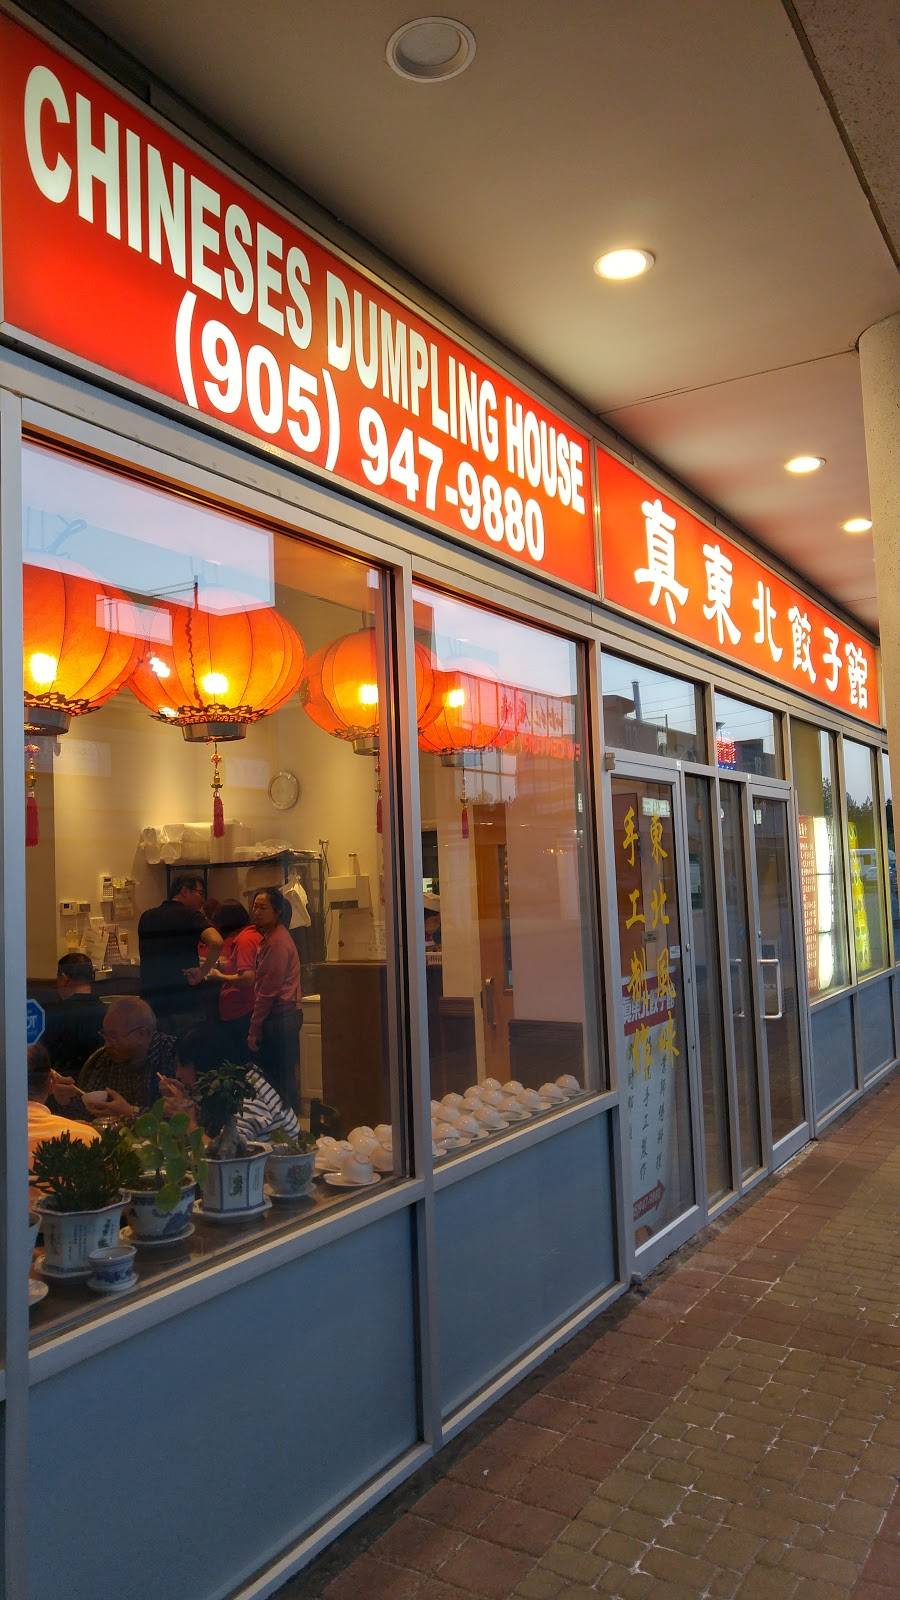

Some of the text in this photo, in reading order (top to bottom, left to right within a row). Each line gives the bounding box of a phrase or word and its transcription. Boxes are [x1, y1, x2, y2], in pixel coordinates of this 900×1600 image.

[24, 65, 586, 515] CHINESES DUMPLING HOUSE
[175, 290, 545, 561] (905) 947-9880
[633, 498, 869, 710] 真東北餃子館
